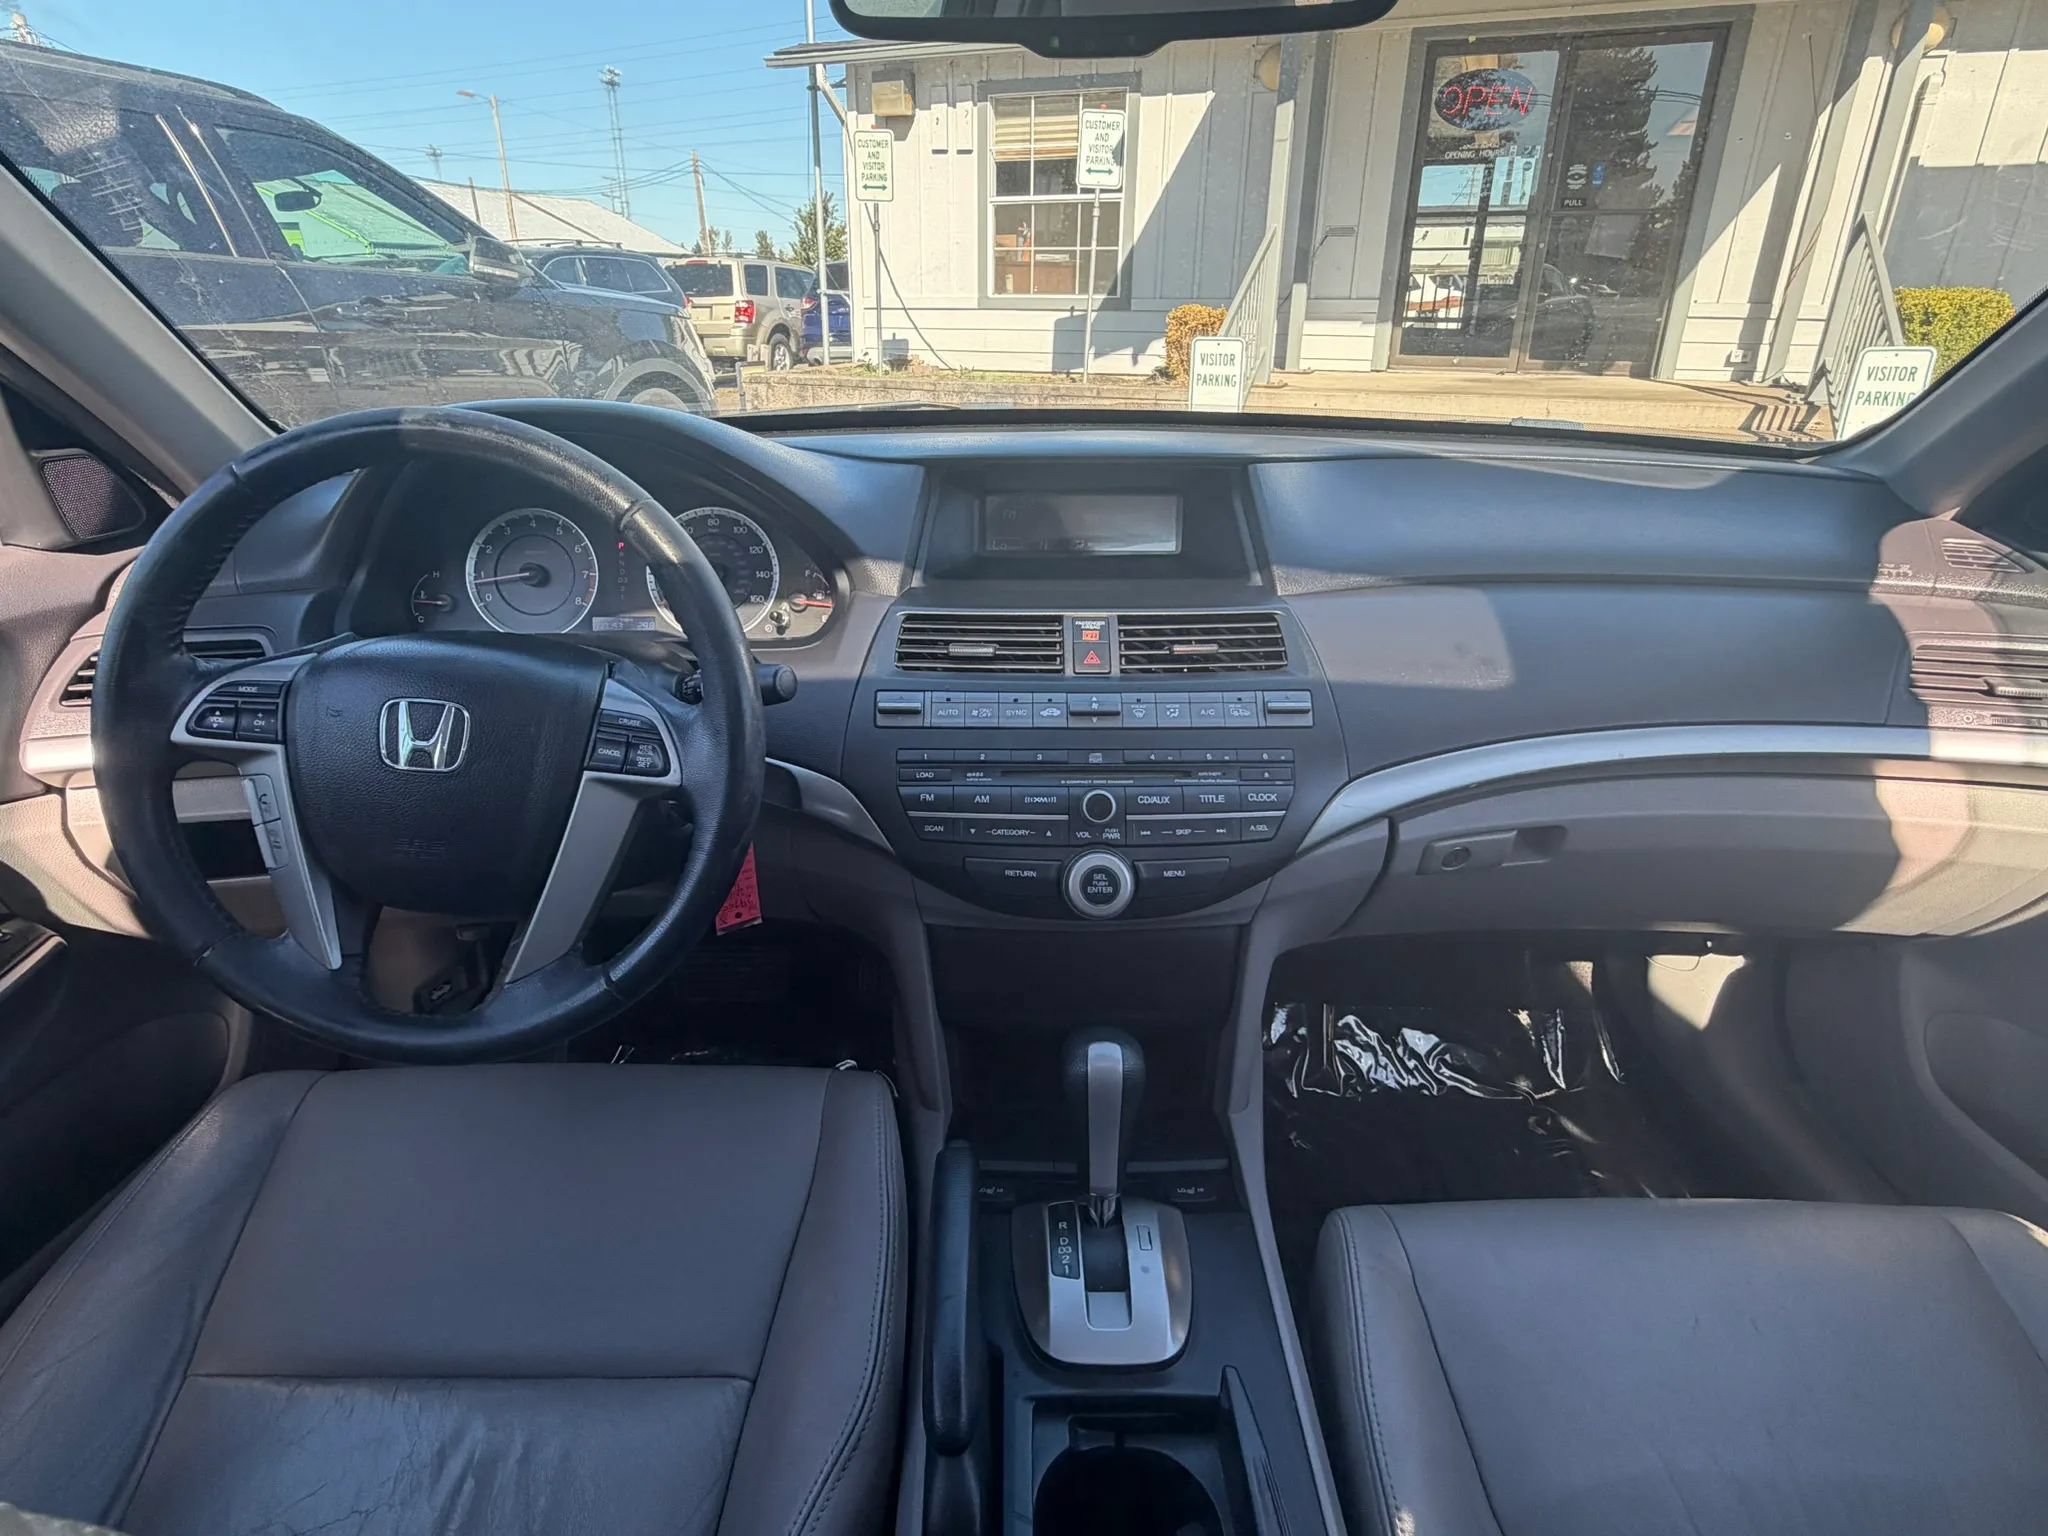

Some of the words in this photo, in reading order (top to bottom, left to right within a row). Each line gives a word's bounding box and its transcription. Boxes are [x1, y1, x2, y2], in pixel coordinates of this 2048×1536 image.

[1443, 83, 1535, 117] OPEN
[1085, 120, 1121, 131] CUSTOMER
[1095, 132, 1110, 142] AND
[858, 139, 889, 149] CUSTOMER
[1088, 143, 1115, 154] VISITOR
[868, 151, 880, 160] AND
[862, 161, 886, 171] VISITOR
[861, 172, 888, 182] PARKING
[1200, 352, 1236, 367] VISITOR
[1866, 366, 1919, 382] VISITOR
[1196, 373, 1237, 387] PARKING
[529, 519, 537, 528] 4
[707, 518, 720, 526] 80
[504, 527, 511, 536] 3
[556, 527, 563, 535] 5
[733, 526, 748, 534] 100
[485, 545, 493, 553] 2
[574, 544, 582, 553] 6
[749, 546, 764, 554] 120
[432, 570, 440, 578] H
[581, 570, 589, 579] 7
[485, 593, 492, 601] 0
[574, 597, 582, 605] 8
[750, 595, 765, 603] 160
[417, 615, 425, 623] C
[937, 709, 959, 717] AUTO
[1005, 709, 1028, 717] SYNC
[1200, 708, 1216, 716] A/C
[618, 717, 641, 727] CRUISE
[597, 747, 621, 757] CANCEL
[1262, 752, 1269, 760] 6
[916, 771, 935, 779] LOAD
[919, 793, 935, 802] FM
[974, 795, 990, 804] AM
[1137, 795, 1170, 804] CD/AUX
[1199, 794, 1225, 803] TITLE
[1247, 793, 1278, 802] CLOCK
[992, 828, 1030, 836] CATEGORY
[1102, 832, 1121, 840] PWR
[1175, 828, 1193, 836] SKIP
[1005, 869, 1037, 877] RETURN
[1093, 873, 1108, 881] SEL
[1163, 870, 1186, 878] MENU
[1087, 886, 1113, 894] ENTER
[1058, 1221, 1068, 1230] R
[1059, 1236, 1069, 1246] D
[1061, 1255, 1070, 1264] 2
[1064, 1264, 1069, 1274] 1
